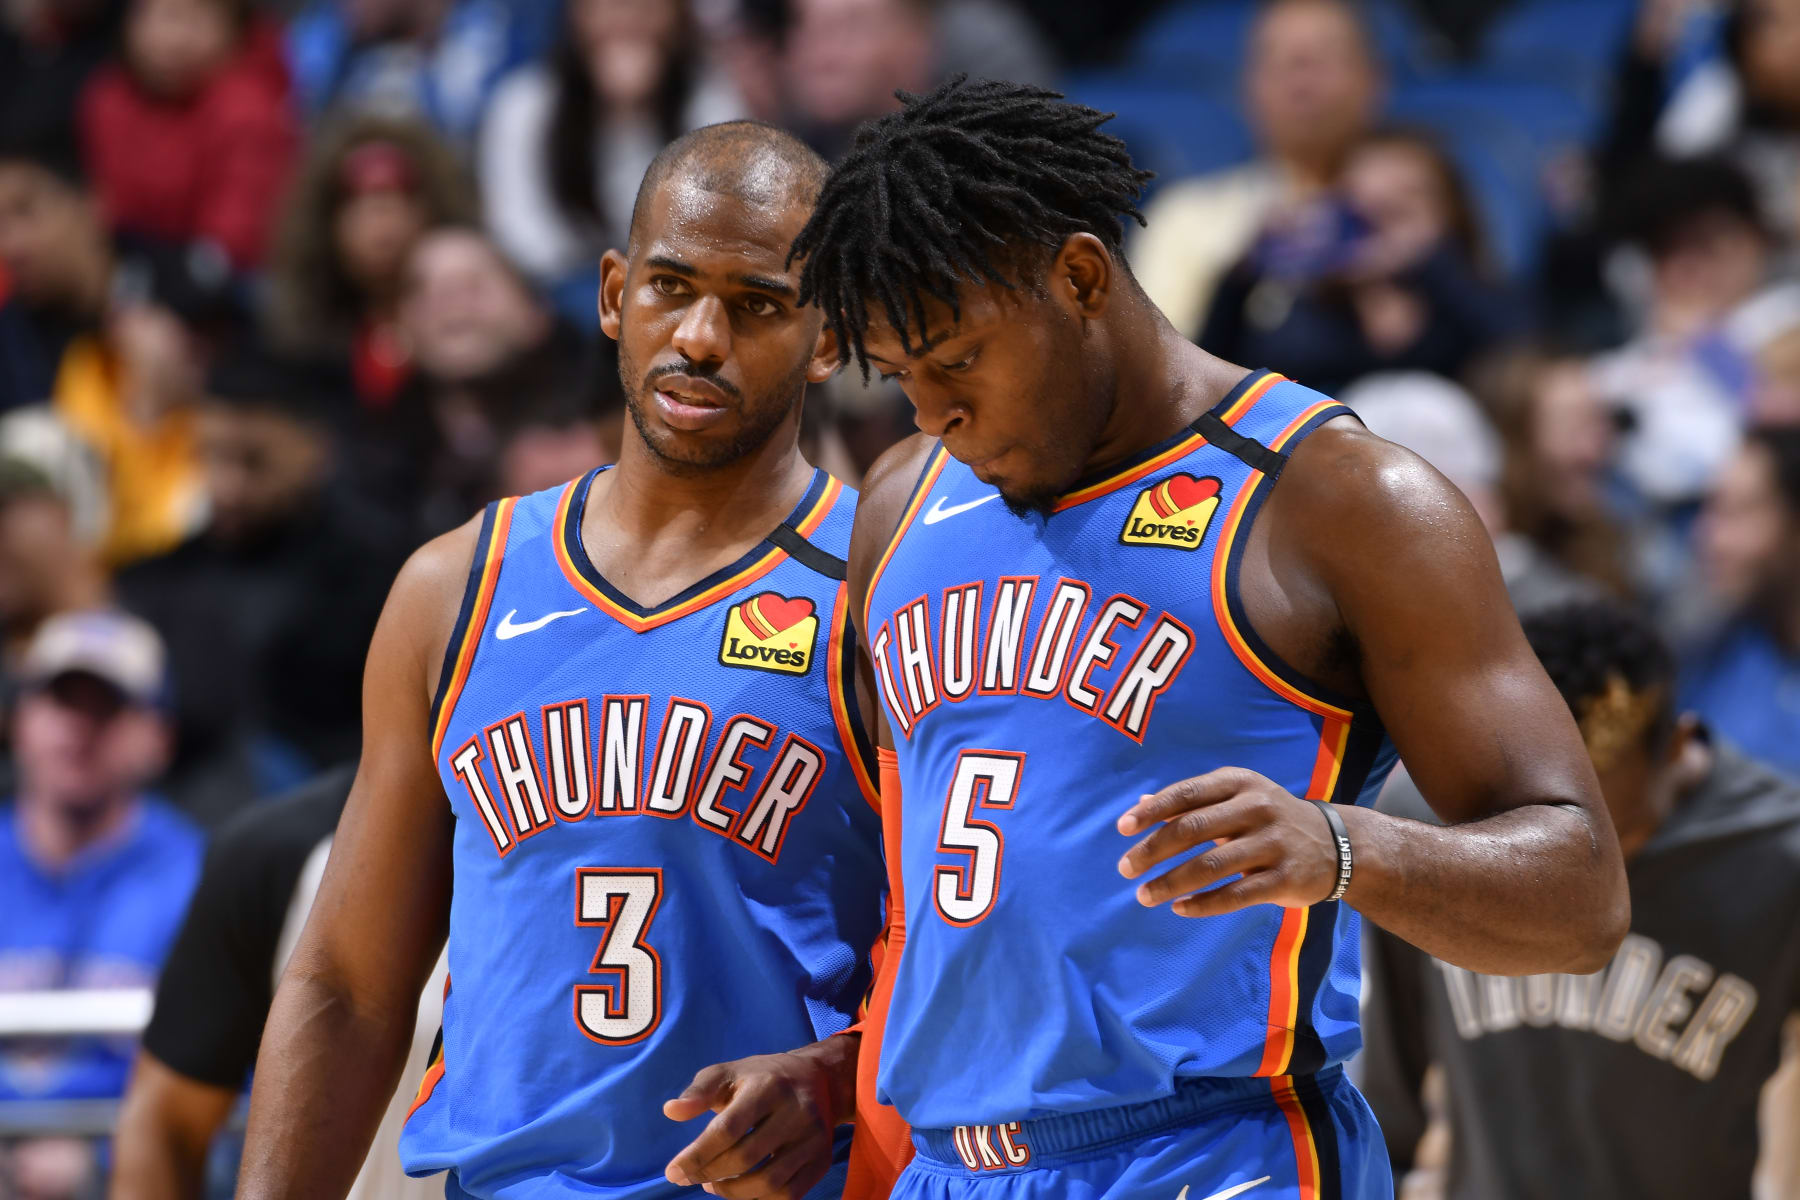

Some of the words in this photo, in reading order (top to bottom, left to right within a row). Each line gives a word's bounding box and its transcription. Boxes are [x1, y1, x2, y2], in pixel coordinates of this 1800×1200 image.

[873, 575, 1197, 745] THUNDER
[449, 694, 826, 865] THUNDER
[933, 748, 1027, 928] 5
[1331, 835, 1352, 899] DIFFERENT
[574, 867, 663, 1046] 3
[953, 1121, 1031, 1172] OKC
